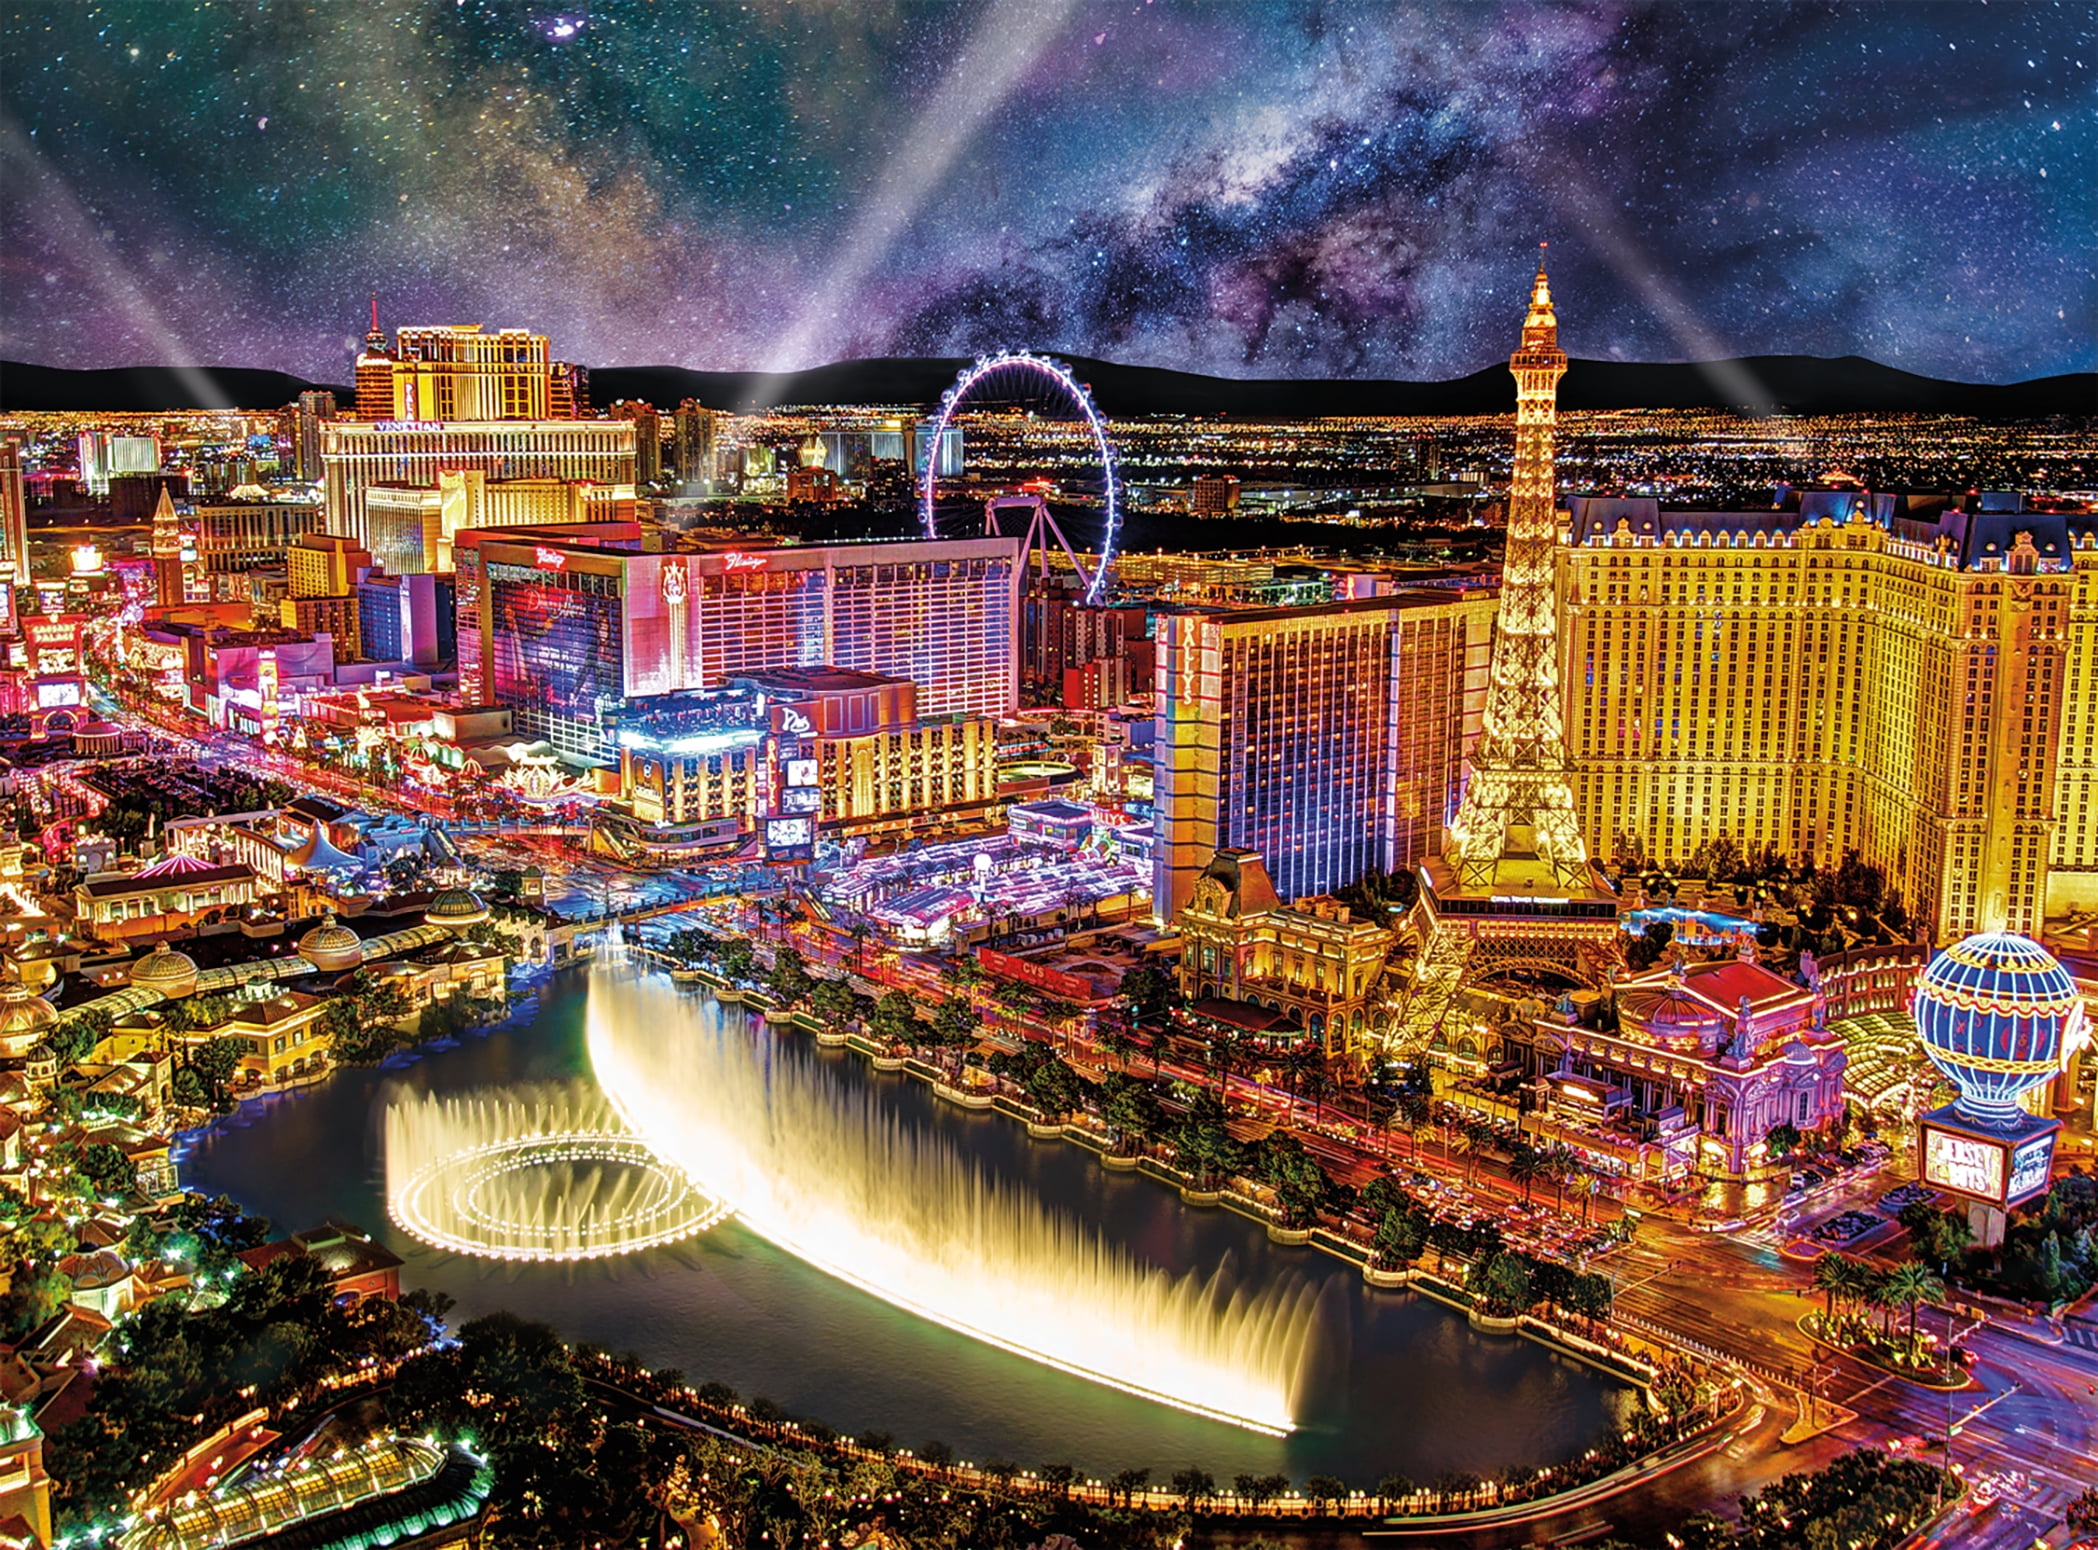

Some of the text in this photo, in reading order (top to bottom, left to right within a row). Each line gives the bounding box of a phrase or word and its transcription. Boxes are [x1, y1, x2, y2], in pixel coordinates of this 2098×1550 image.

[375, 421, 443, 432] VENETIAN
[35, 632, 74, 643] PALACE
[1182, 617, 1196, 705] BALLYS
[767, 739, 777, 808] BALLYS
[1023, 963, 1044, 978] CVS
[1939, 1137, 1993, 1168] JERSEY
